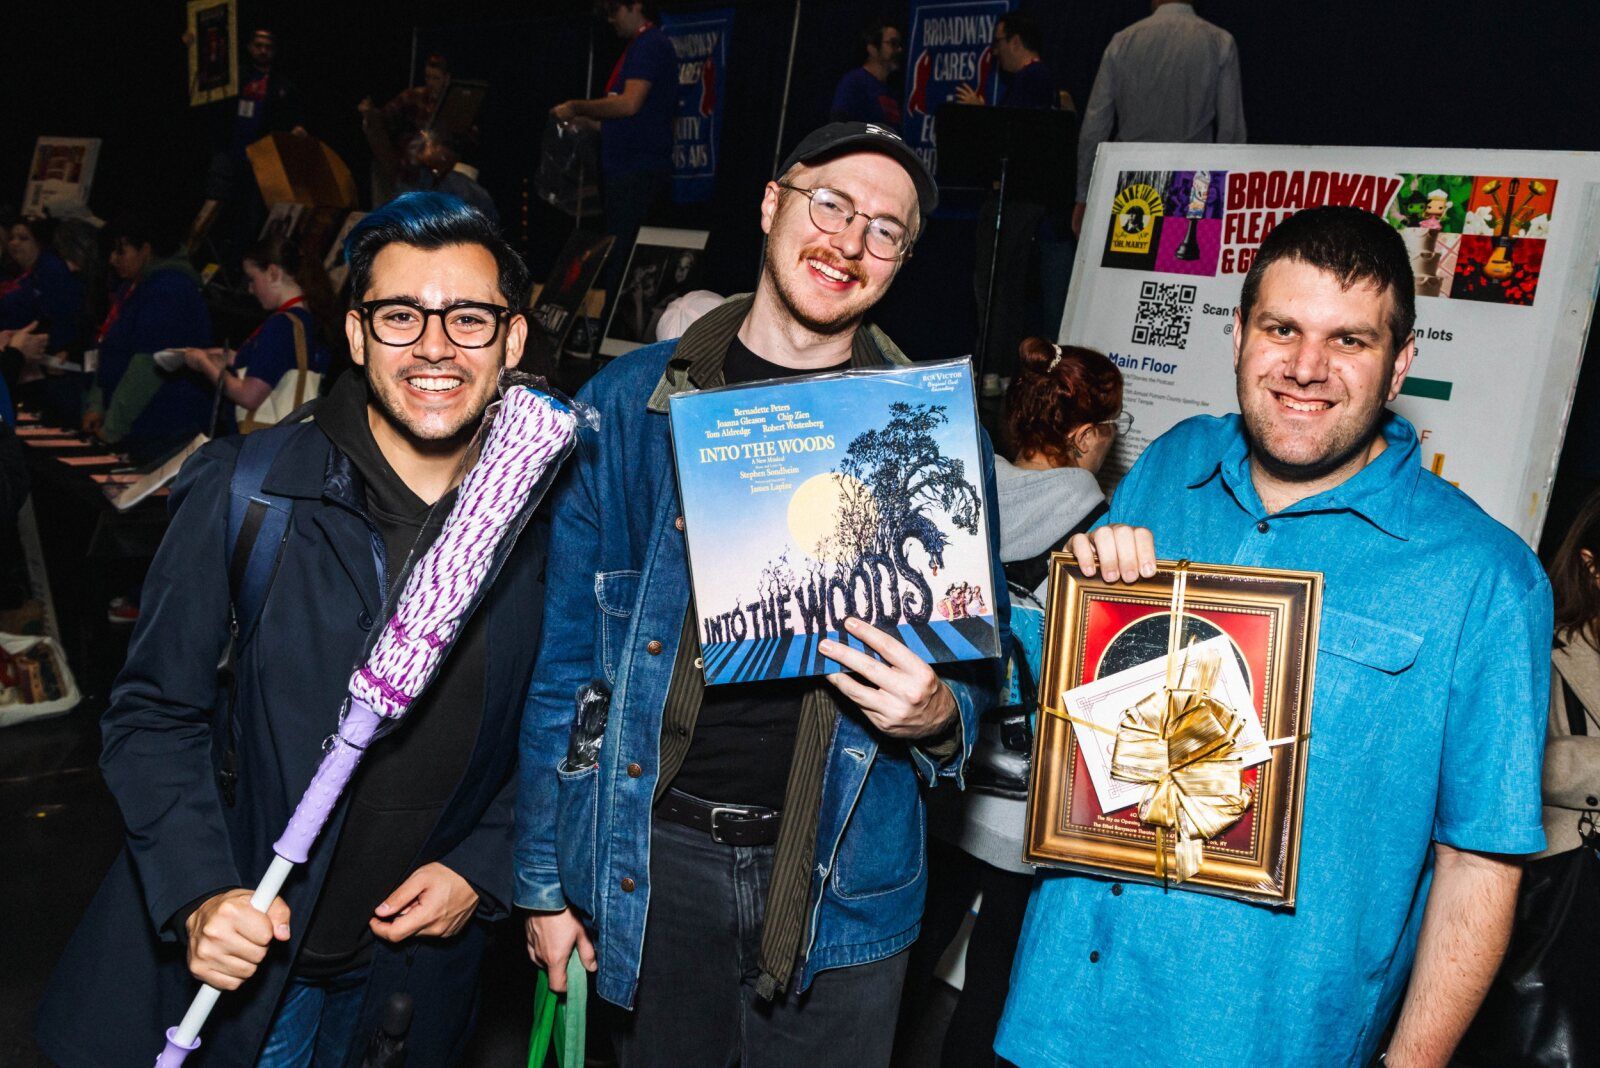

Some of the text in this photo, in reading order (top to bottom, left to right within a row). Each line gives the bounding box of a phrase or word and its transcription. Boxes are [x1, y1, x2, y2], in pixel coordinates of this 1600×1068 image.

[923, 14, 997, 47] BROADWAY
[933, 52, 976, 81] CARES
[1227, 170, 1401, 219] BROADWAY
[1202, 303, 1229, 316] Scan
[1427, 327, 1453, 341] lots
[1141, 357, 1178, 375] Floor
[734, 404, 790, 417] Bernadette Peters
[777, 411, 810, 422] Chip Zien
[717, 417, 766, 429] Joanna Gleason
[762, 420, 824, 433] Robert Westenberg
[705, 427, 751, 439] Tom Aldredge
[699, 434, 836, 463] INTO THE WOODS
[739, 466, 799, 480] Stephen Sondheim
[751, 485, 769, 494] James
[704, 530, 938, 644] INTO THE WOODS
